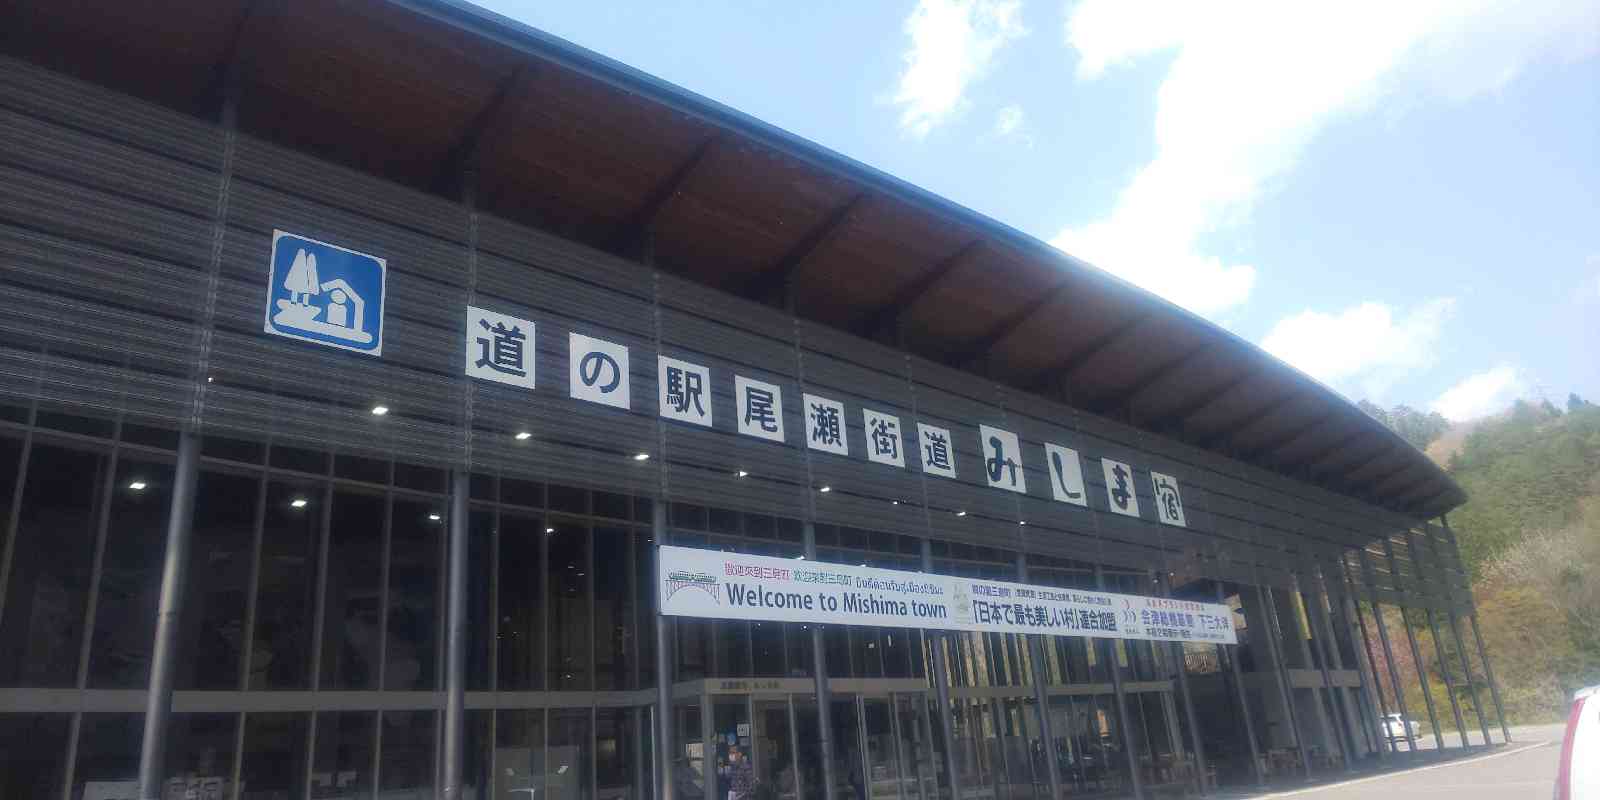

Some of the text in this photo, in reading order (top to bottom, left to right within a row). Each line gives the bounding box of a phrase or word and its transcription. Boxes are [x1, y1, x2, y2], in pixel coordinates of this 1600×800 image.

[725, 582, 948, 619] Welcome to Mishima town
